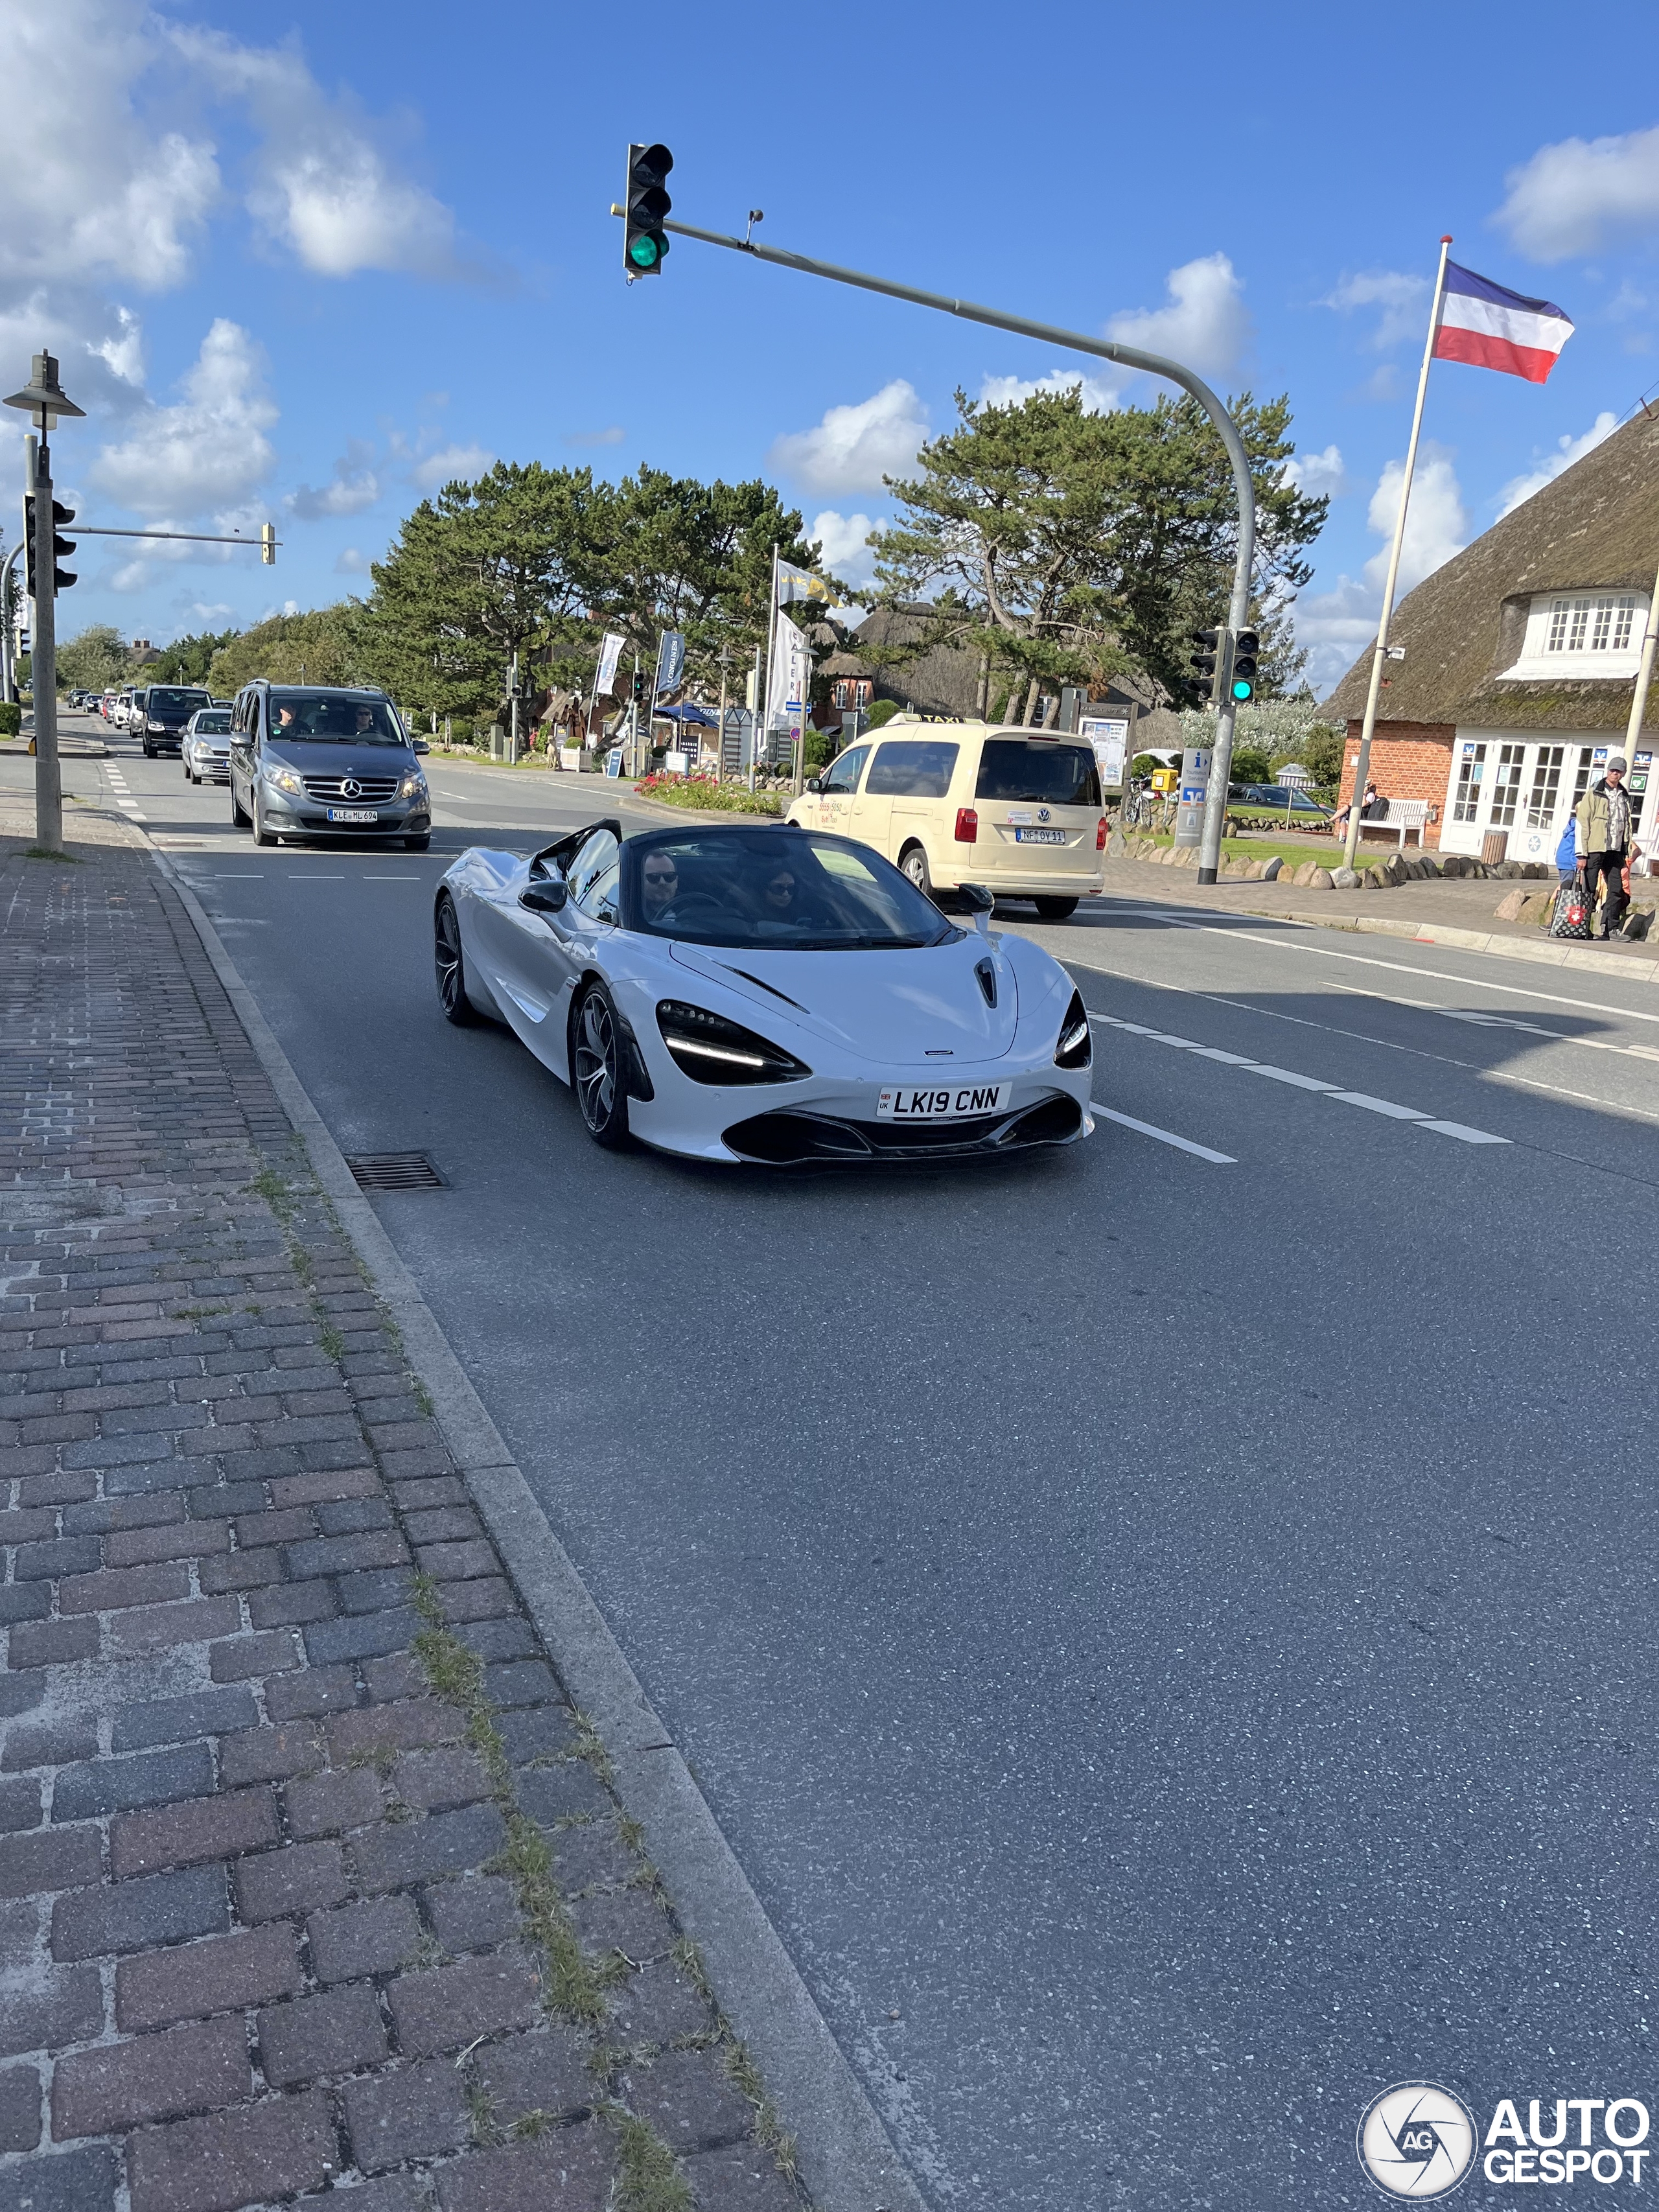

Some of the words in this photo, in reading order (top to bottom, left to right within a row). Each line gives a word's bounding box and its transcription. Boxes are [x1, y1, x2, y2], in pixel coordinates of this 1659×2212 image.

[667, 640, 678, 684] LONGINES
[923, 715, 960, 724] TAXI
[334, 811, 347, 819] KLE
[364, 811, 377, 820] 694
[1024, 830, 1034, 839] NF
[1040, 831, 1050, 840] OY
[1052, 832, 1062, 841] 11
[894, 1091, 951, 1113] LK19
[955, 1086, 1000, 1112] CNN
